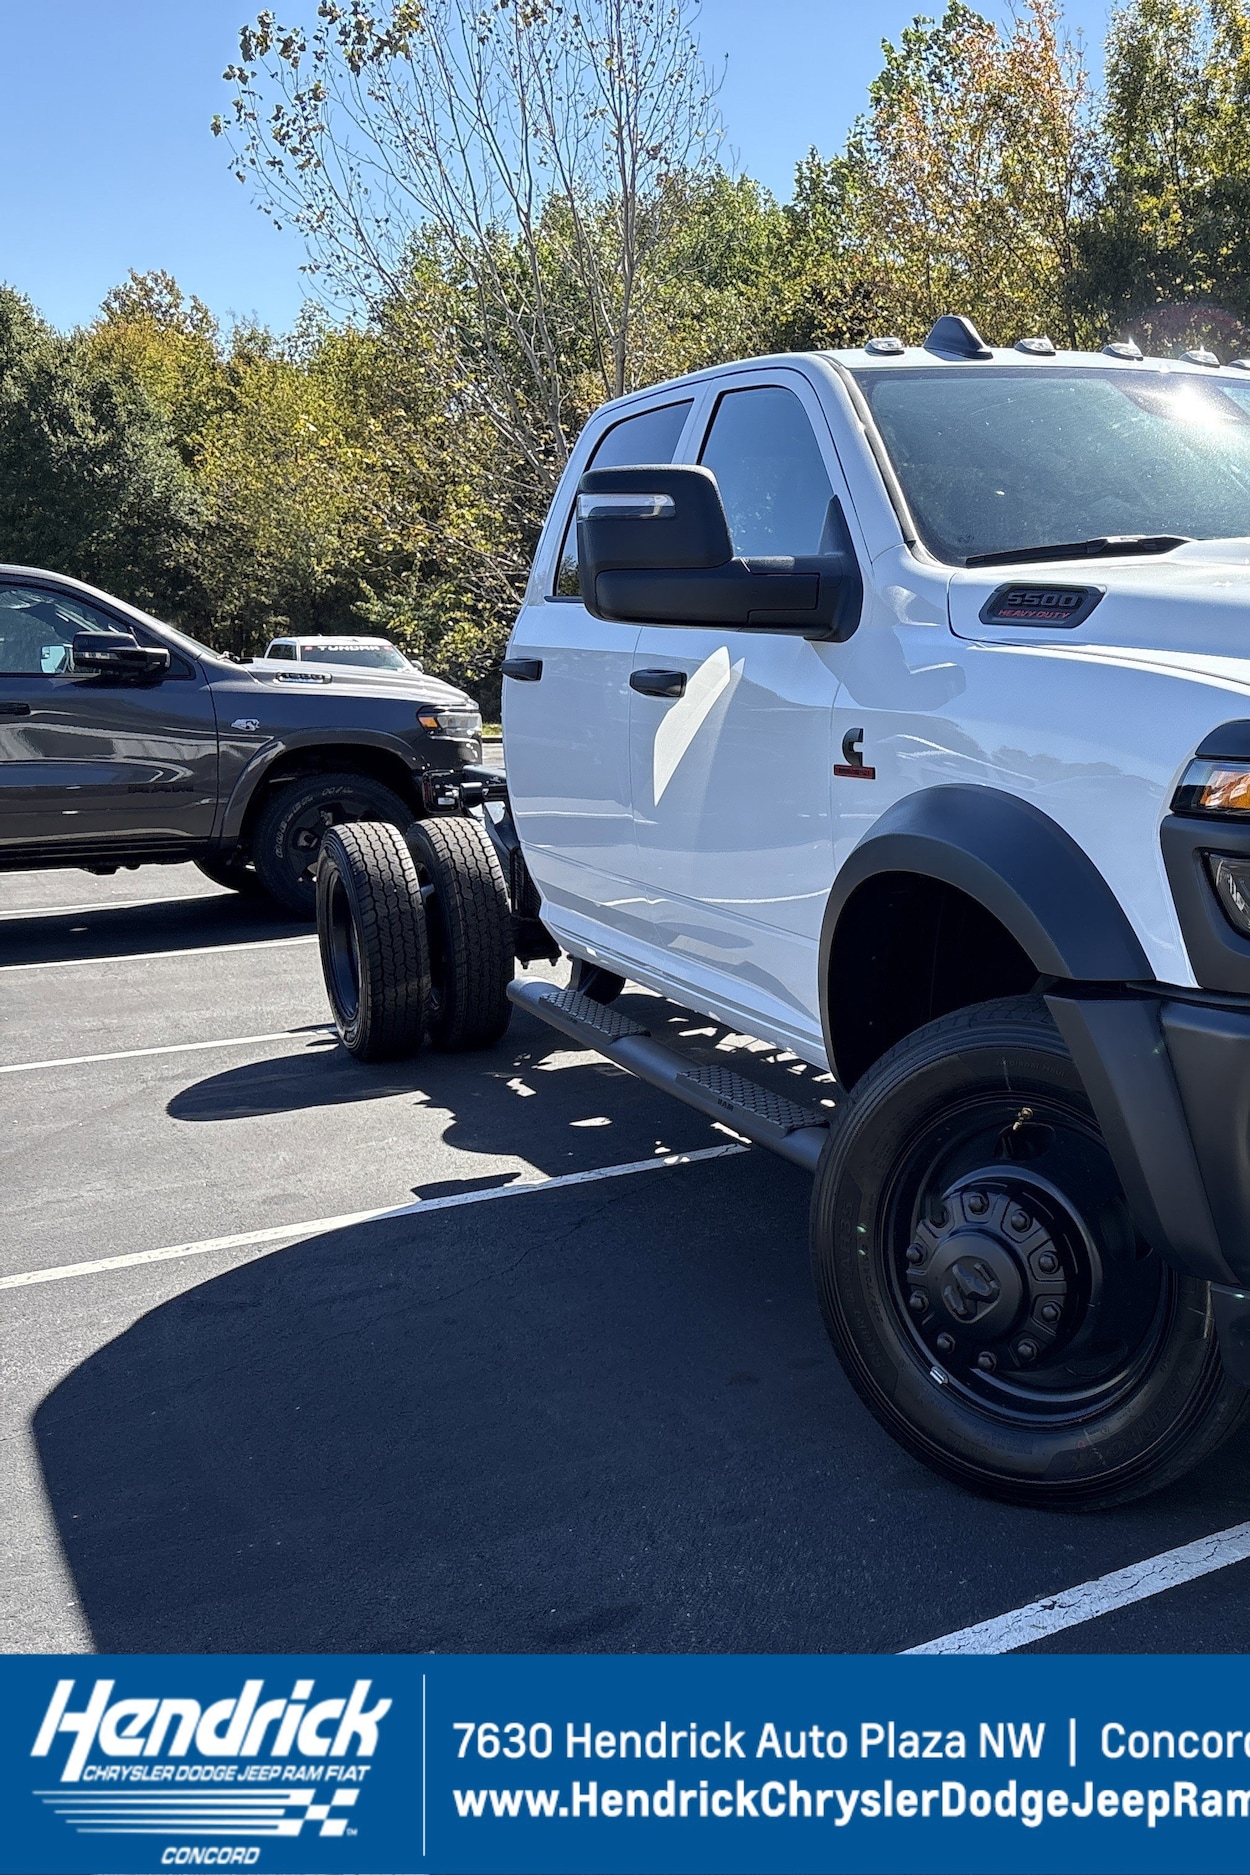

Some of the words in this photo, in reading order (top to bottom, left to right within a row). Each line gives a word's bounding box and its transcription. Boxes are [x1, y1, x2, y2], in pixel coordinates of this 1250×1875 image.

[1007, 592, 1079, 608] 5500
[998, 609, 1036, 618] HEAVY
[1036, 611, 1071, 620] DUTY
